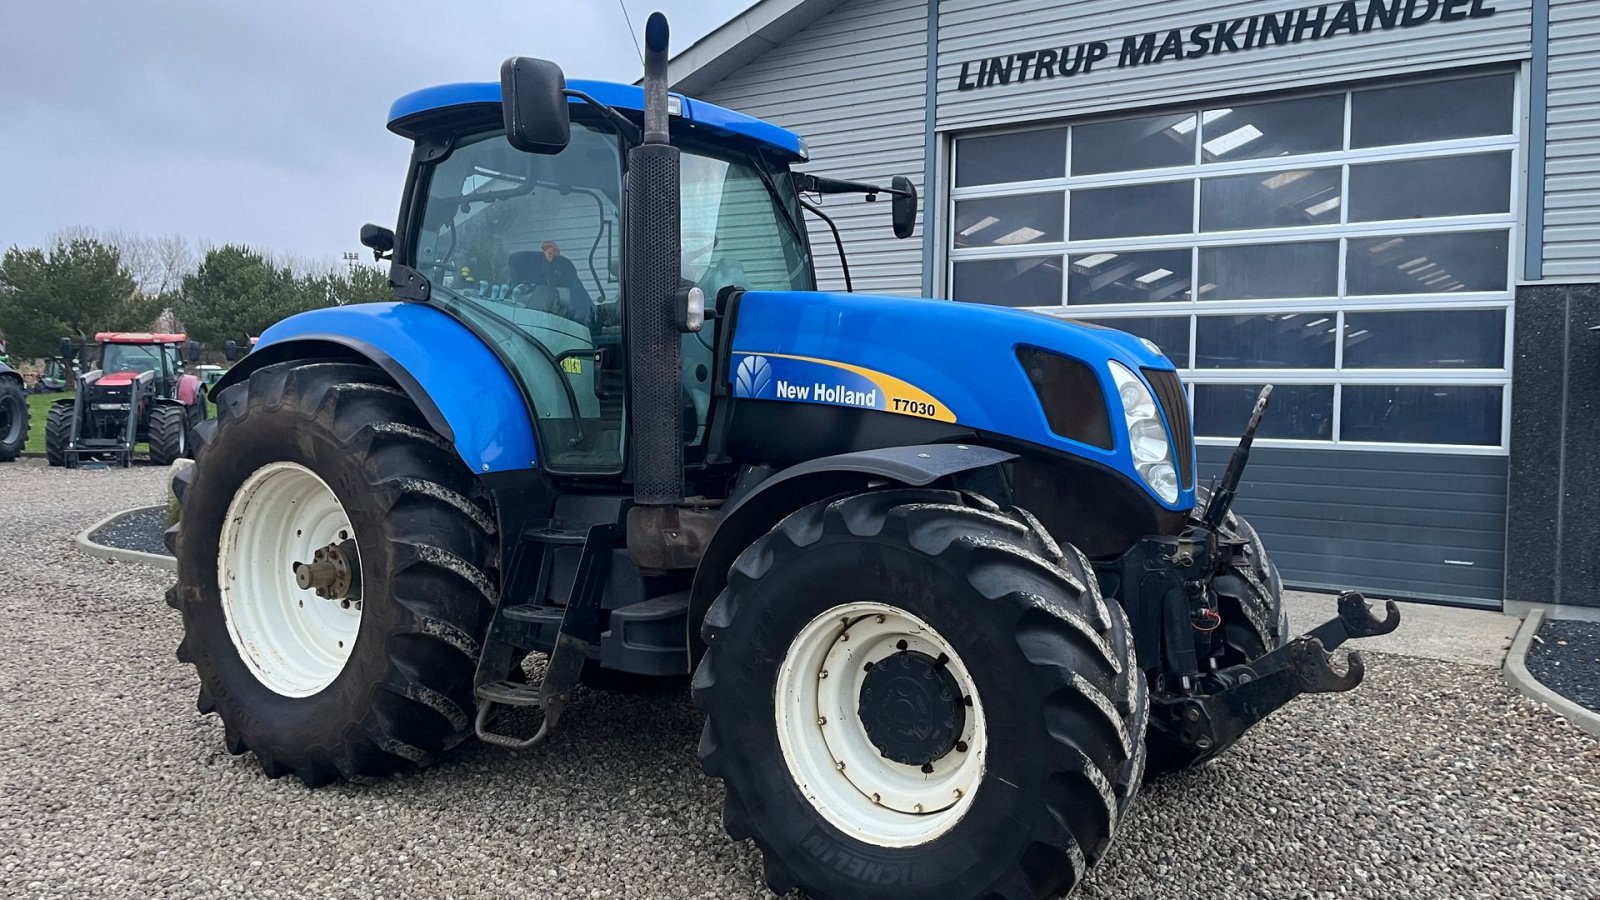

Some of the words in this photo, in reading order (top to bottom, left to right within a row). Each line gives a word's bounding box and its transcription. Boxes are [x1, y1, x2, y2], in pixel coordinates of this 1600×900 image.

[957, 41, 1109, 92] LINTRUP
[1118, 0, 1496, 69] MASKINHANDEL
[777, 380, 809, 399] New
[814, 383, 876, 407] Holland
[893, 399, 936, 416] T7030
